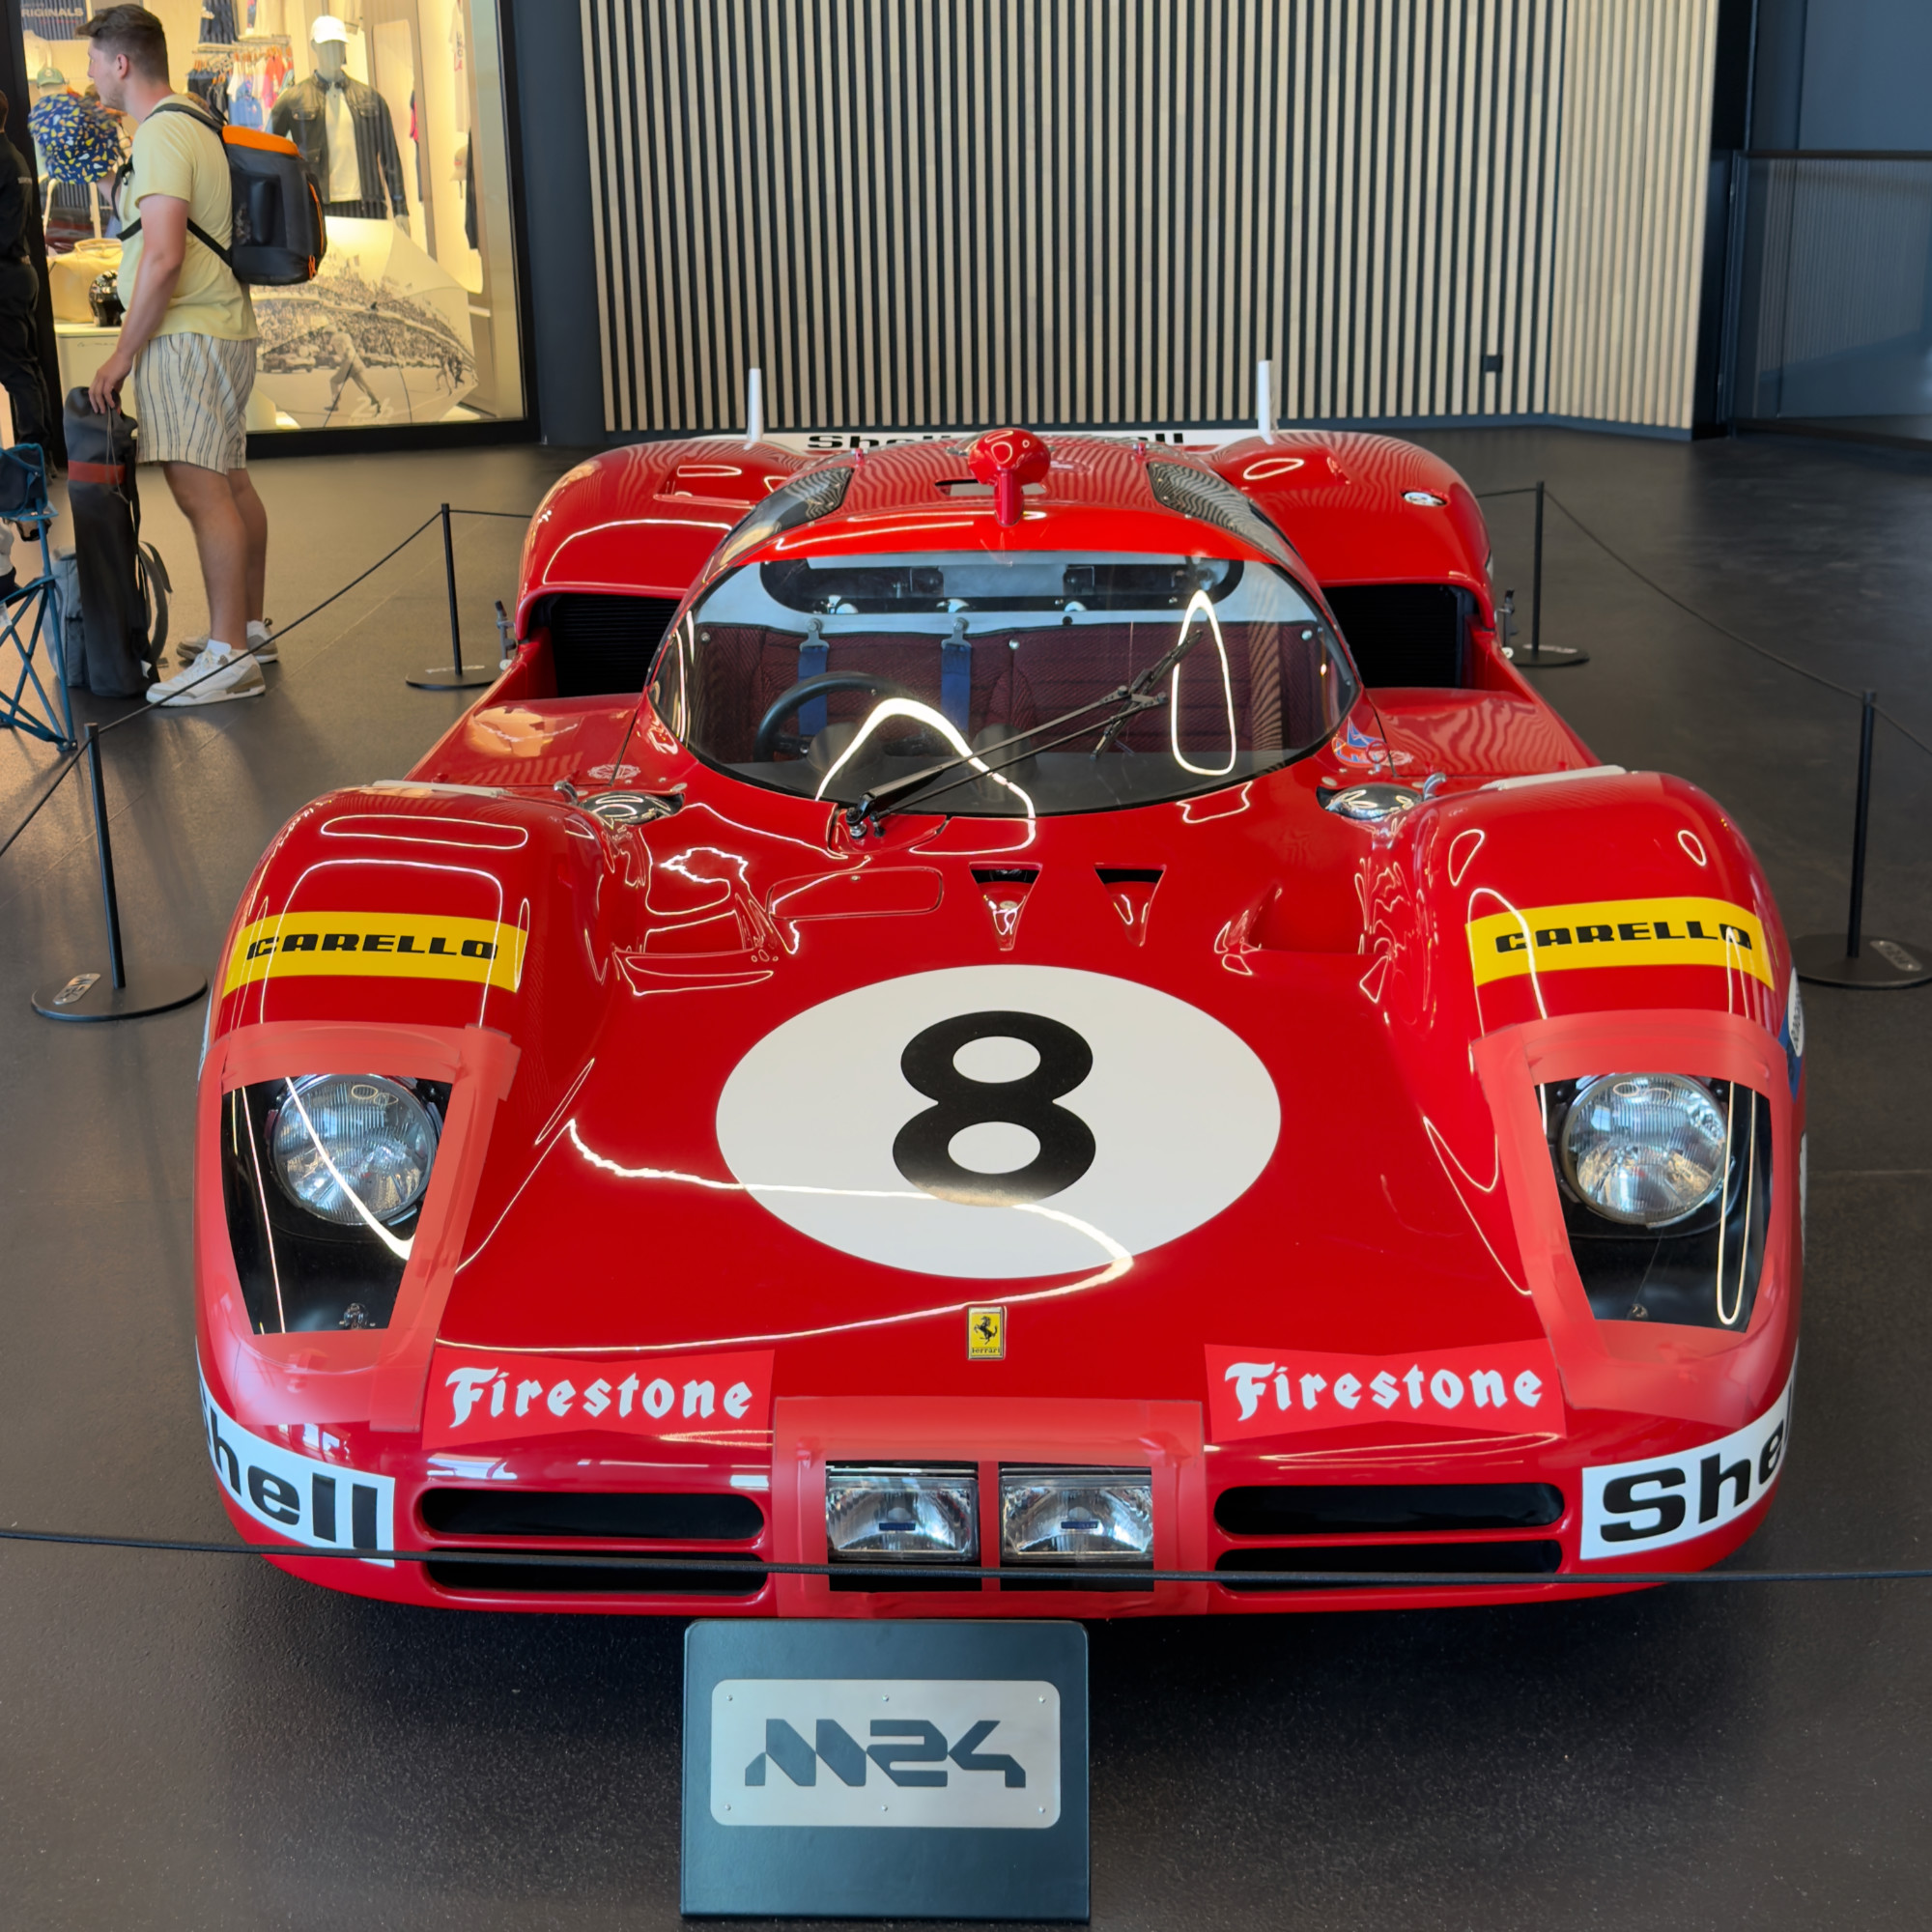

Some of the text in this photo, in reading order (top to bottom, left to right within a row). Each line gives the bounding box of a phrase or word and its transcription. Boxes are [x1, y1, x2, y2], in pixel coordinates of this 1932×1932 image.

[20, 8, 84, 17] RIGINALS
[246, 933, 499, 961] CARELLO
[1494, 920, 1752, 953] CARELLO
[893, 1009, 1096, 1208] 8
[445, 1366, 754, 1428] Firestone
[1224, 1361, 1544, 1422] Firestone
[200, 1376, 378, 1552] hell
